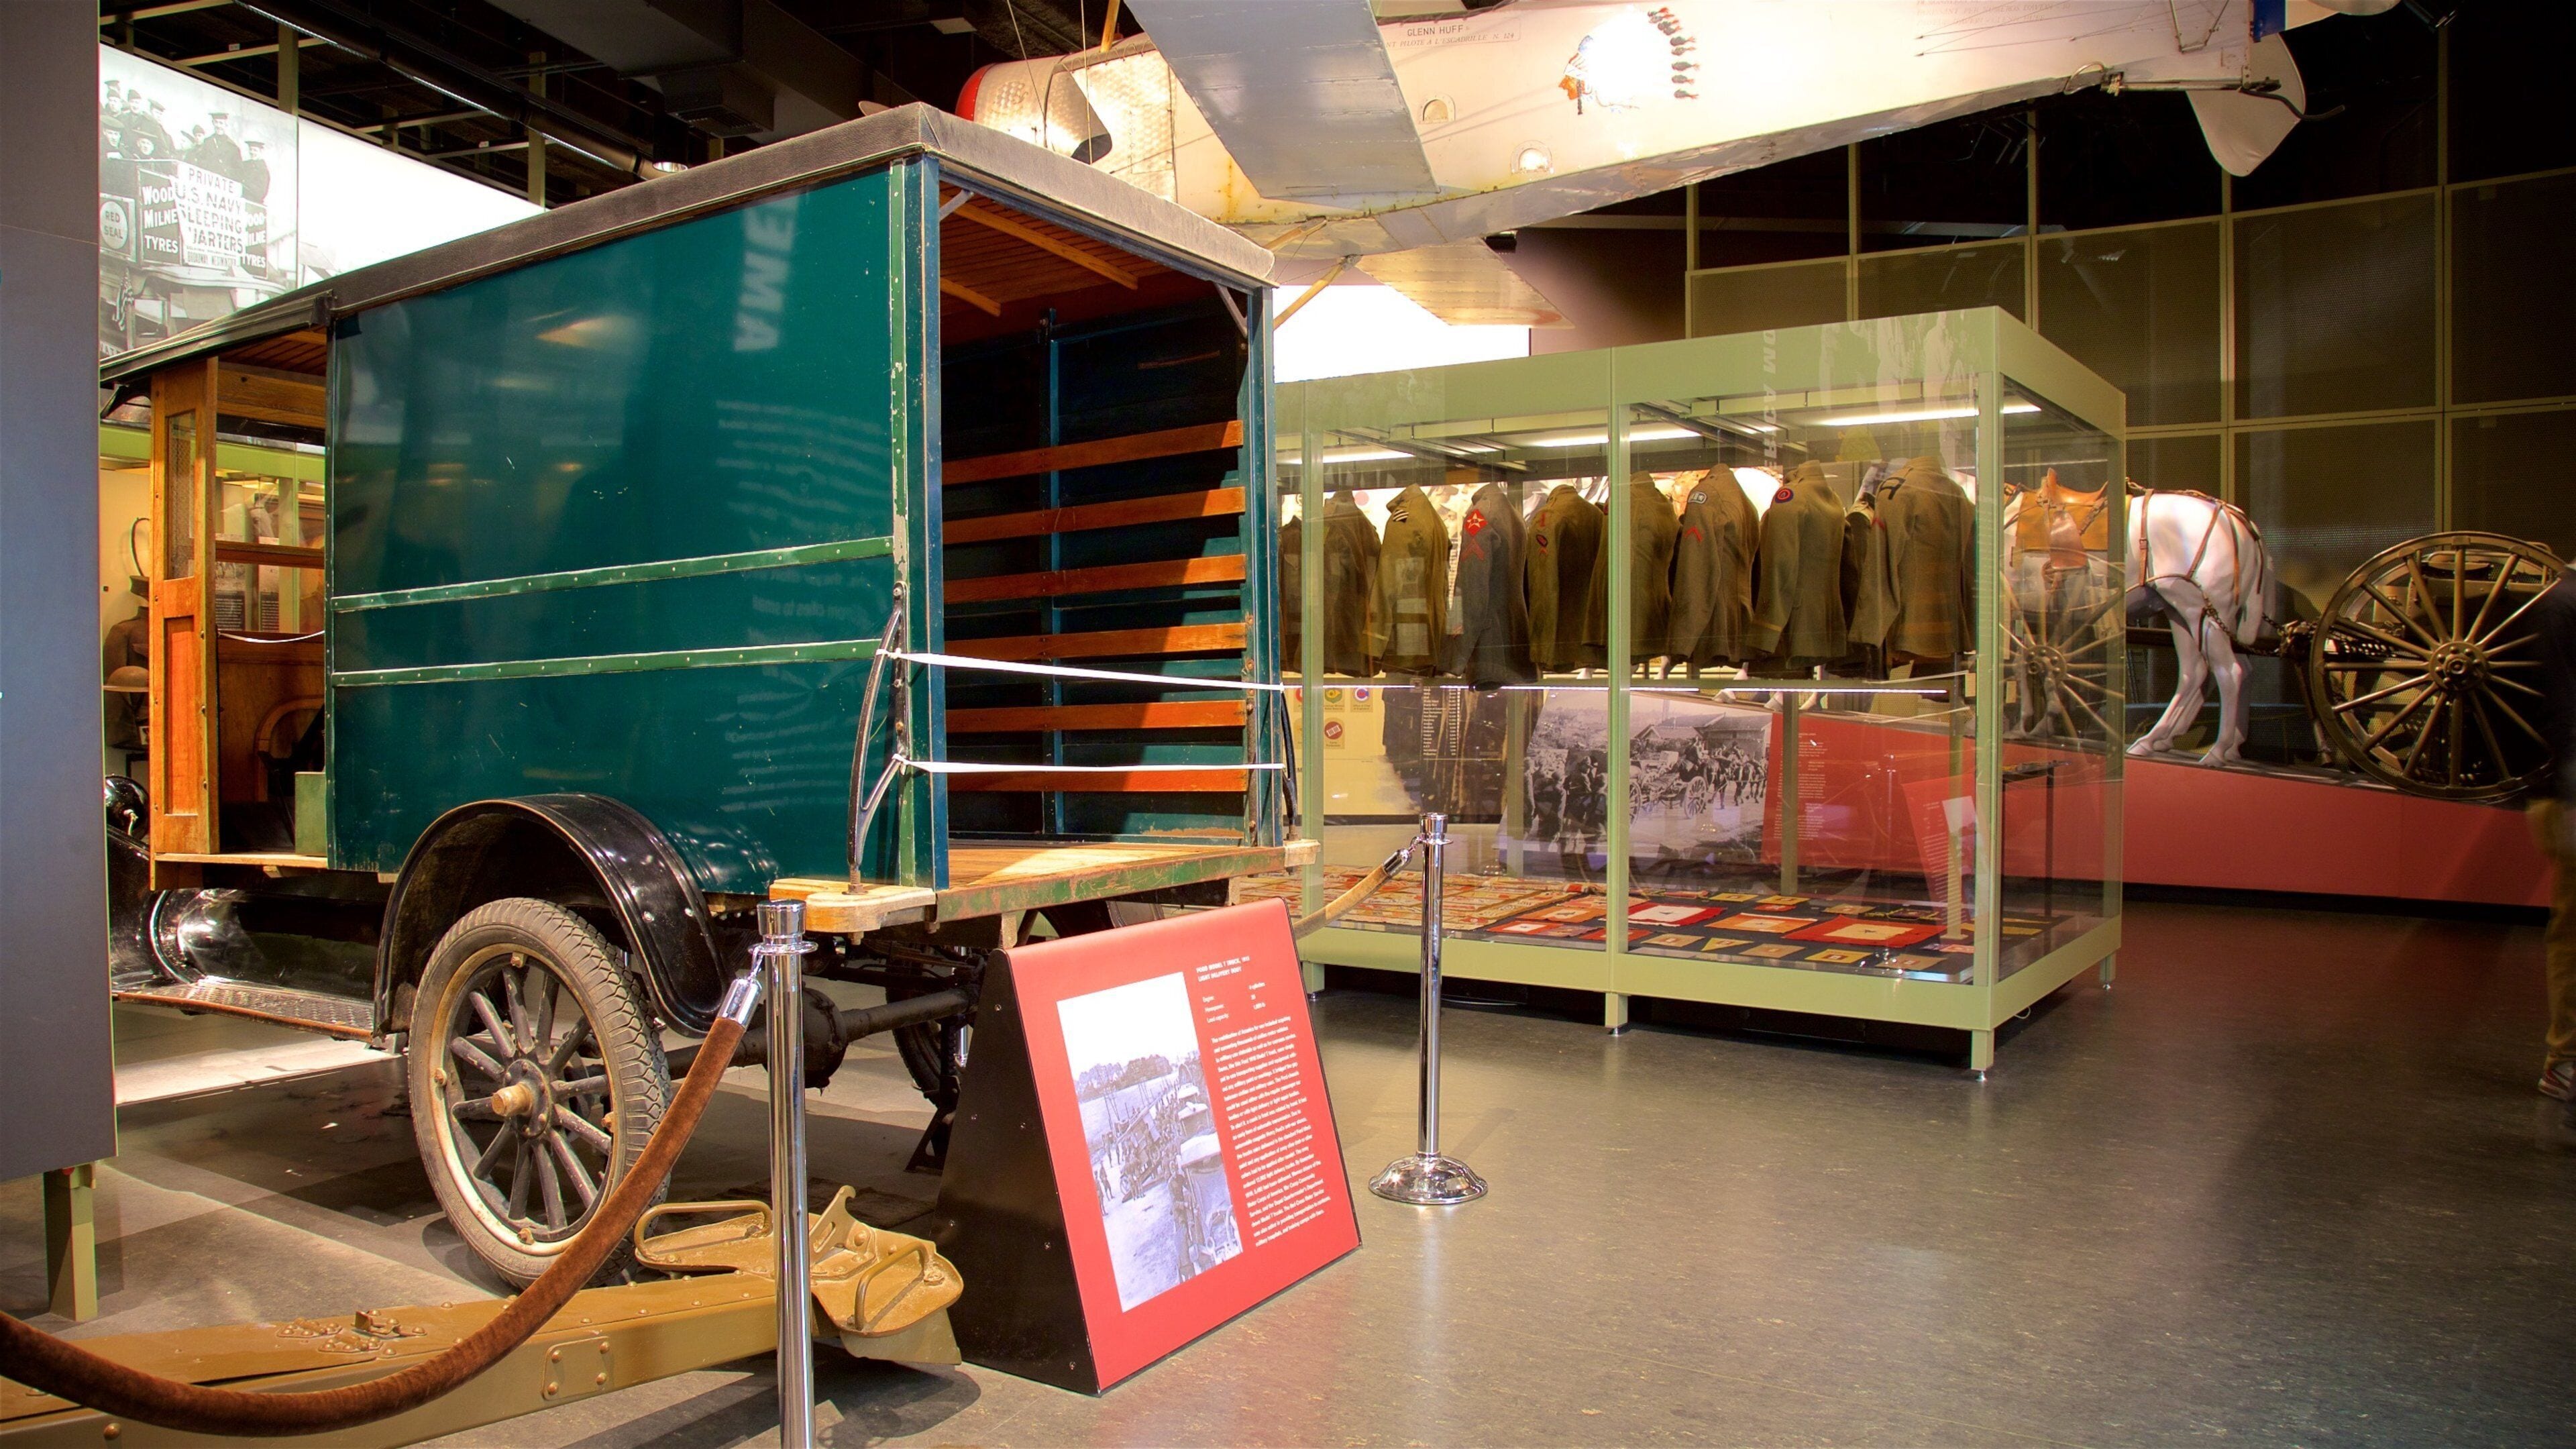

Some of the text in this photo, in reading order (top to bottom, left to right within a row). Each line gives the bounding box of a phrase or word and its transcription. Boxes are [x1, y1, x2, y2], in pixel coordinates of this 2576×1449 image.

[1407, 24, 1464, 37] GLENN HUFF
[189, 167, 234, 193] PRIVATE
[206, 191, 241, 215] NAVY
[105, 211, 121, 223] RED
[144, 208, 178, 229] MILNE
[103, 225, 123, 239] SEAL
[144, 234, 178, 254] TYRES
